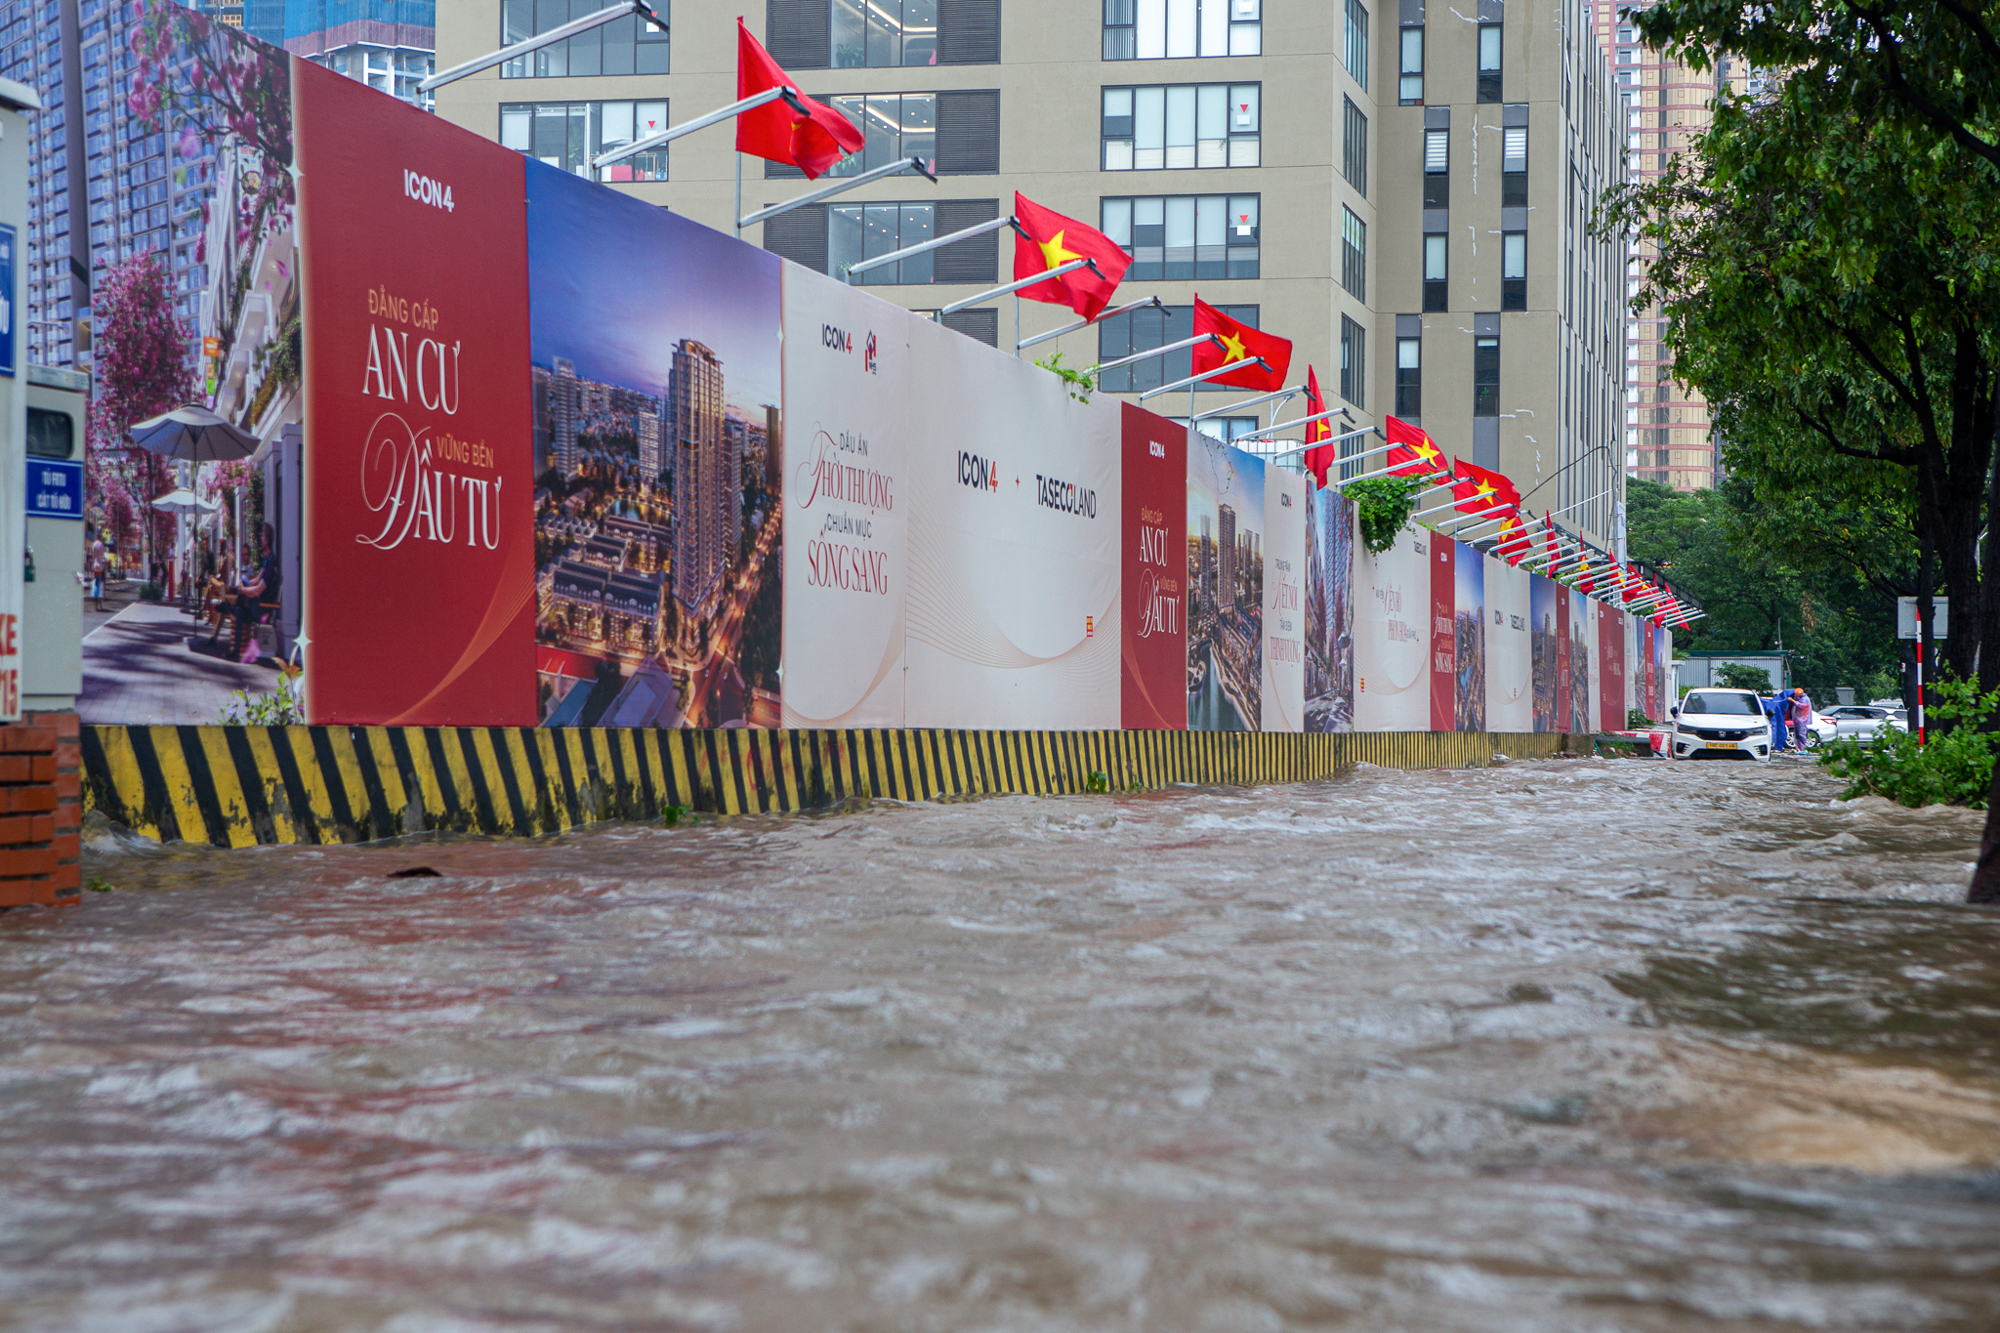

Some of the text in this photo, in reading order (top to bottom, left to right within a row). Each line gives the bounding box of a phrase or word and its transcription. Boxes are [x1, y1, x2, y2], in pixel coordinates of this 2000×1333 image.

[403, 168, 455, 213] ICON4
[412, 298, 439, 332] CẤP
[822, 323, 853, 355] ICON4
[362, 323, 461, 415] AN CƯ
[435, 432, 494, 469] VỮNG BỀN
[840, 429, 856, 454] DẤU
[1149, 440, 1165, 459] ICON4
[355, 412, 502, 550] ĐẦU TƯ
[795, 421, 893, 515] THỜI THƯỢNG
[957, 450, 999, 493] ICON4
[855, 517, 872, 541] MỰC
[1139, 525, 1169, 567] AN CƯ
[807, 523, 888, 596] SỐNG SANG
[1167, 595, 1180, 635] TƯ
